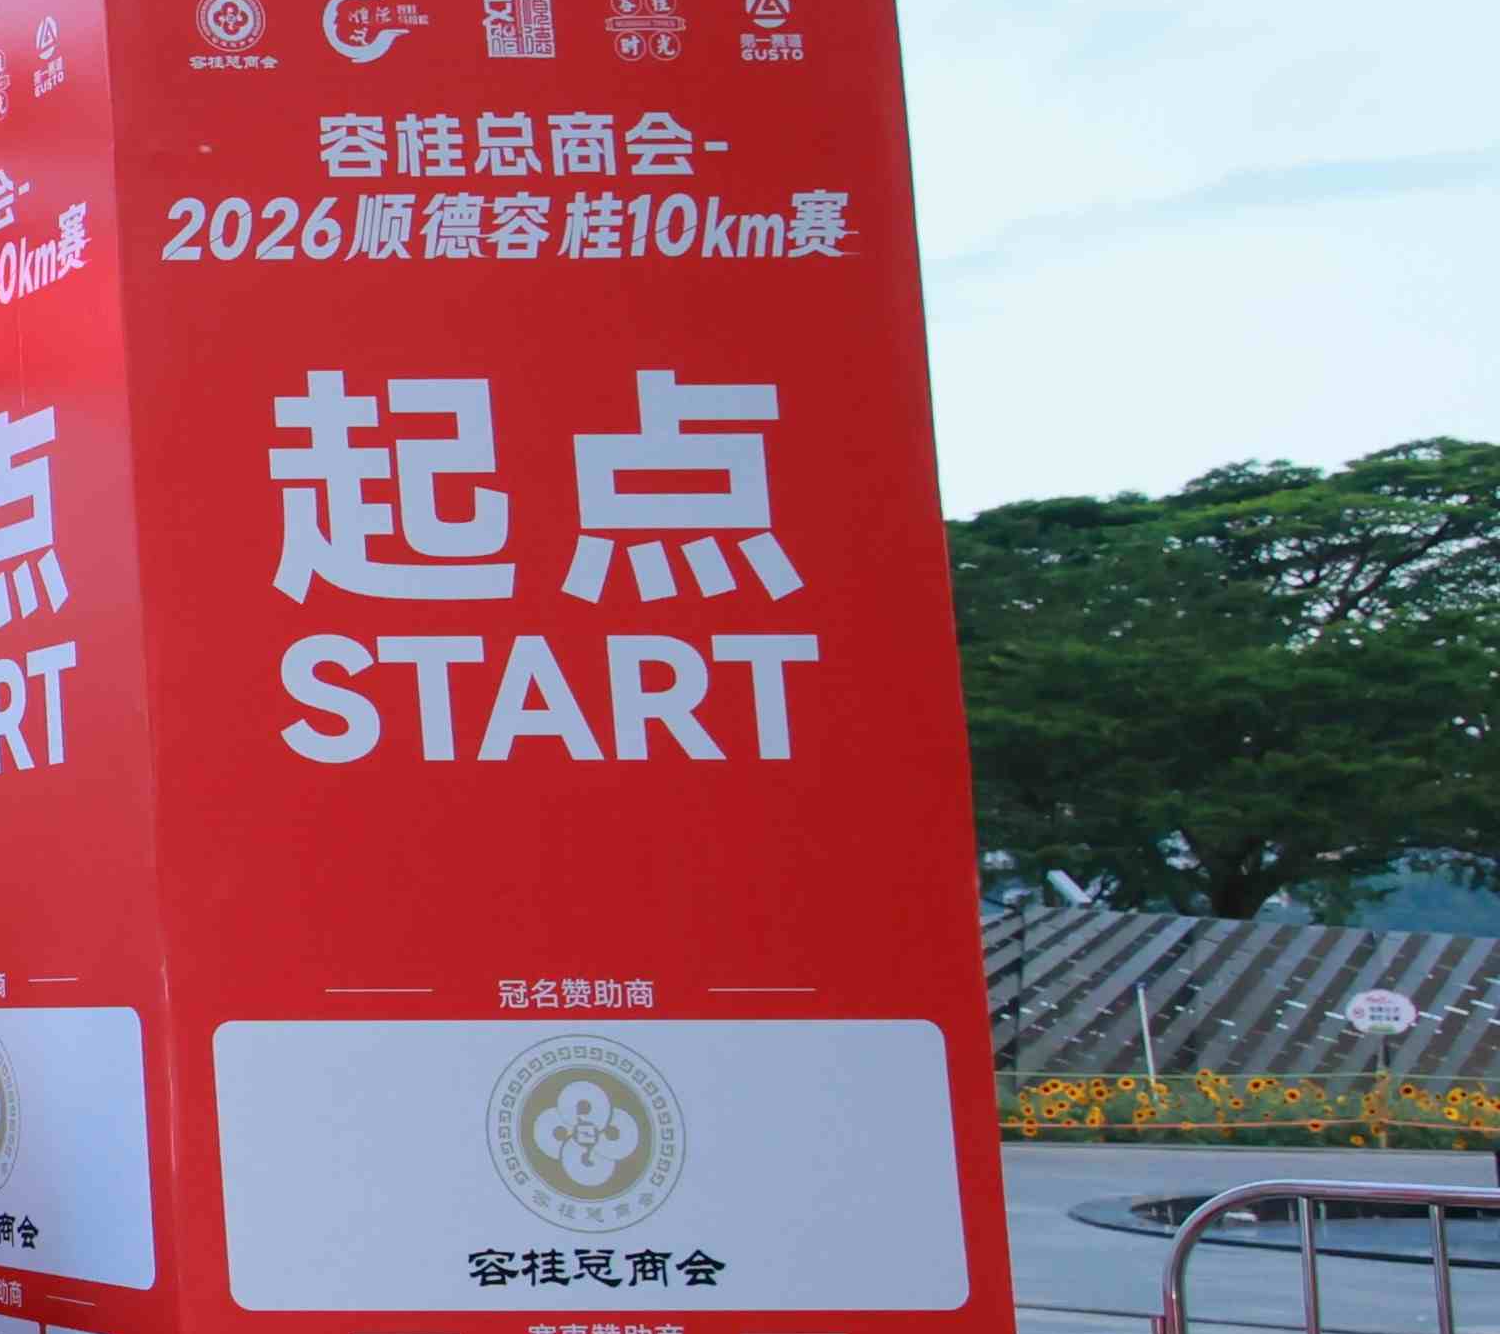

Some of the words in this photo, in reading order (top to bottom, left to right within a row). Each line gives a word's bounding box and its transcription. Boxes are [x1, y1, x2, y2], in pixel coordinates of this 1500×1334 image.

[741, 48, 804, 61] GUSTO
[319, 110, 729, 178] 容桂总商会-
[161, 188, 861, 262] 2026顺德容桂10km赛
[268, 369, 804, 605] 起点
[280, 634, 820, 764] START
[497, 978, 656, 1011] 冠名赞助商
